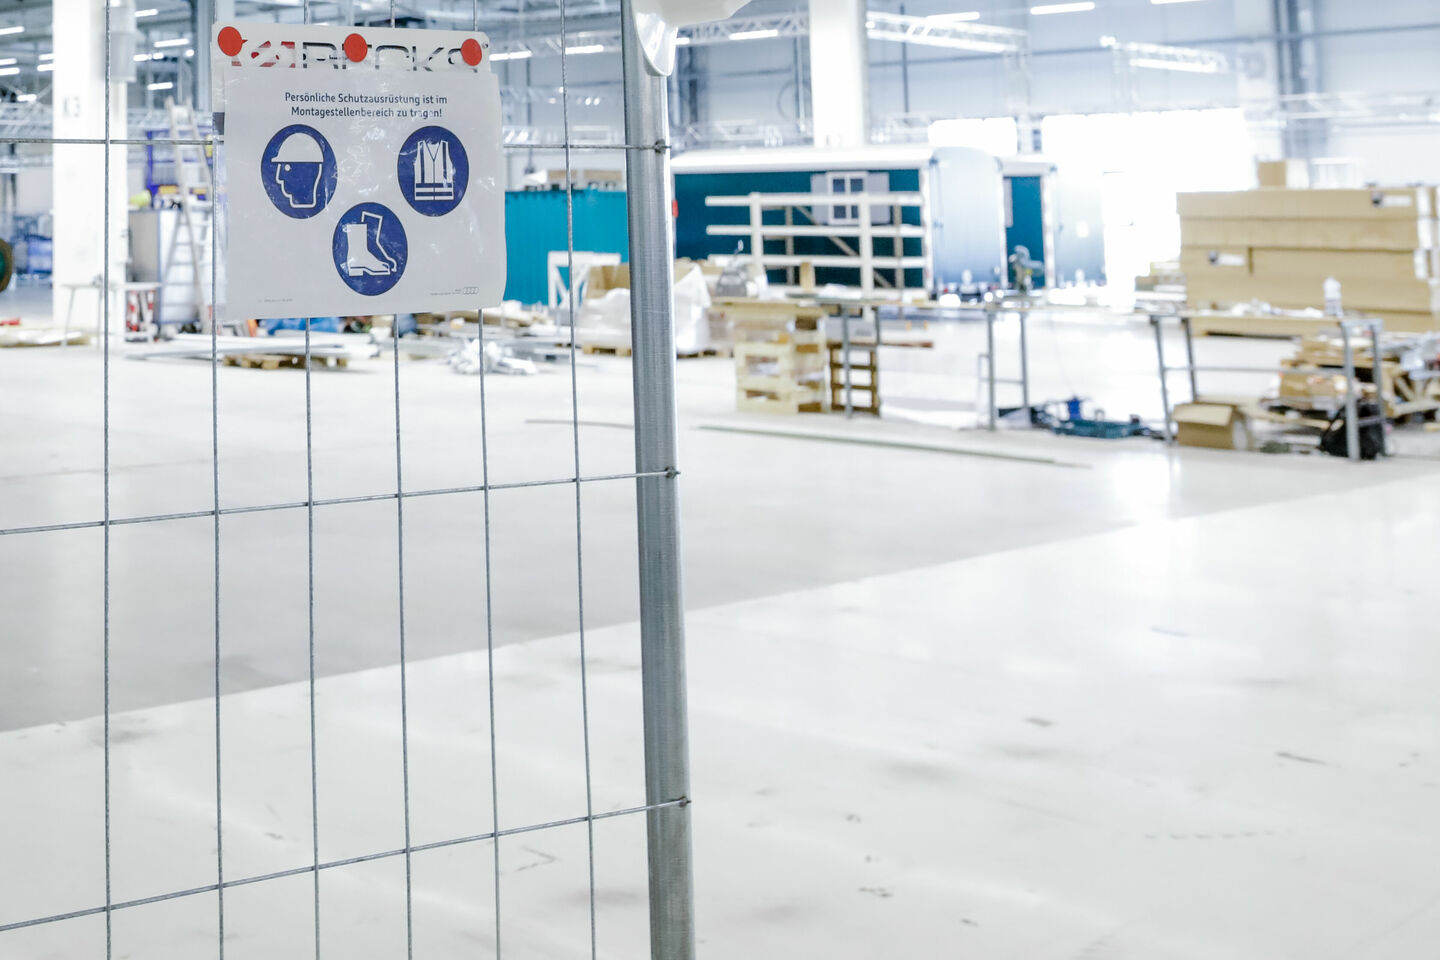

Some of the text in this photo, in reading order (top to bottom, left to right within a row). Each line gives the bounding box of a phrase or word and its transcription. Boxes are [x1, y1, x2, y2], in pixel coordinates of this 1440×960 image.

[285, 92, 448, 106] Persönliche Schutzausrüstung ist im
[291, 106, 394, 119] Montagestellenbereich
